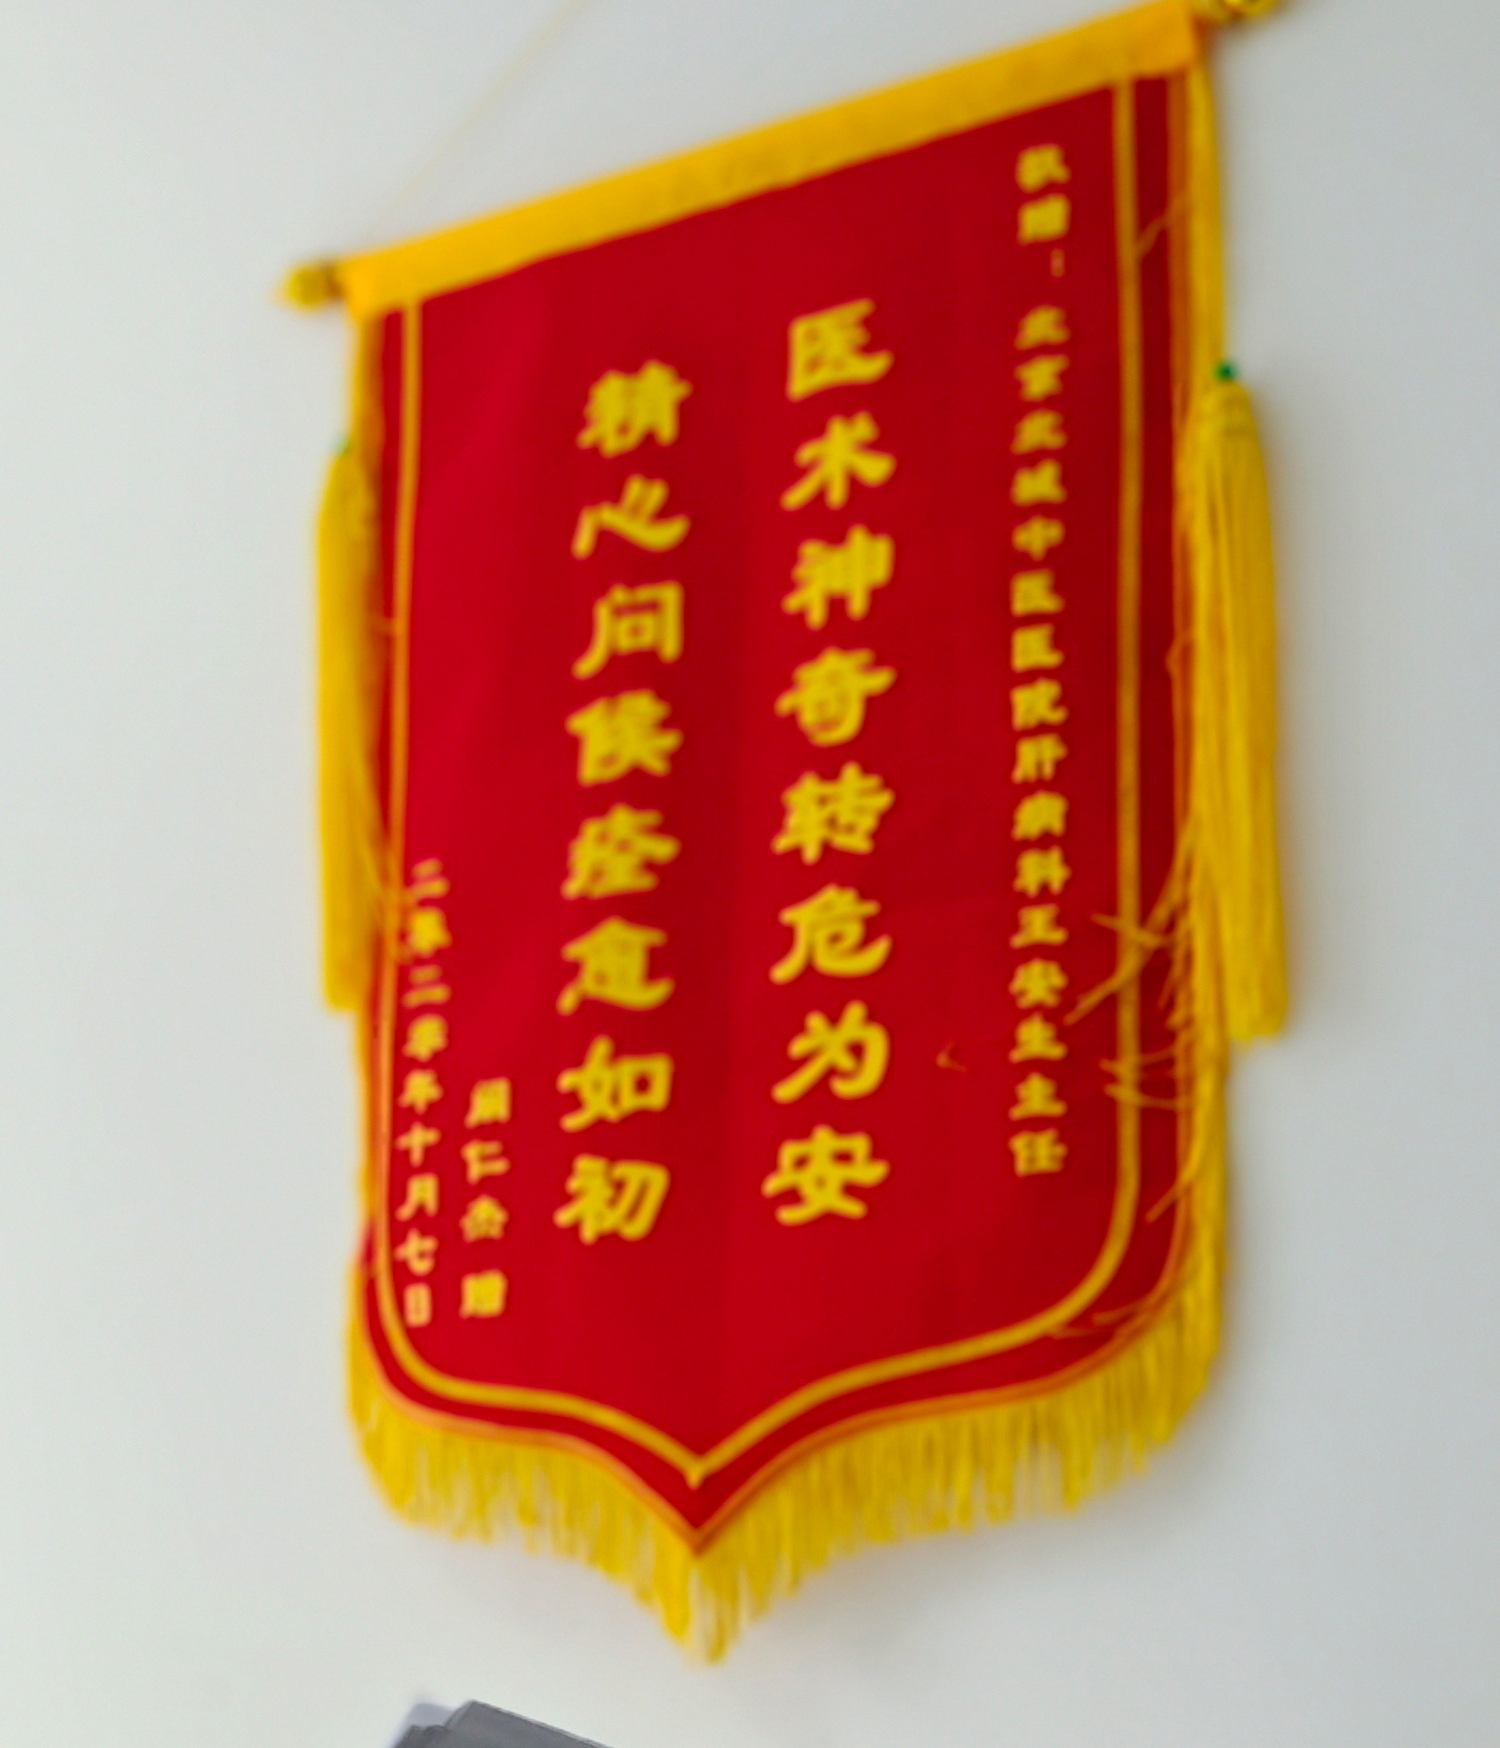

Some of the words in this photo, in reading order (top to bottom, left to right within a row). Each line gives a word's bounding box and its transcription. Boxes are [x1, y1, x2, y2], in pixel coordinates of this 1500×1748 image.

[553, 359, 693, 1246] 精心问候痊愈如初
[760, 298, 897, 1226] 医术神奇转危为安
